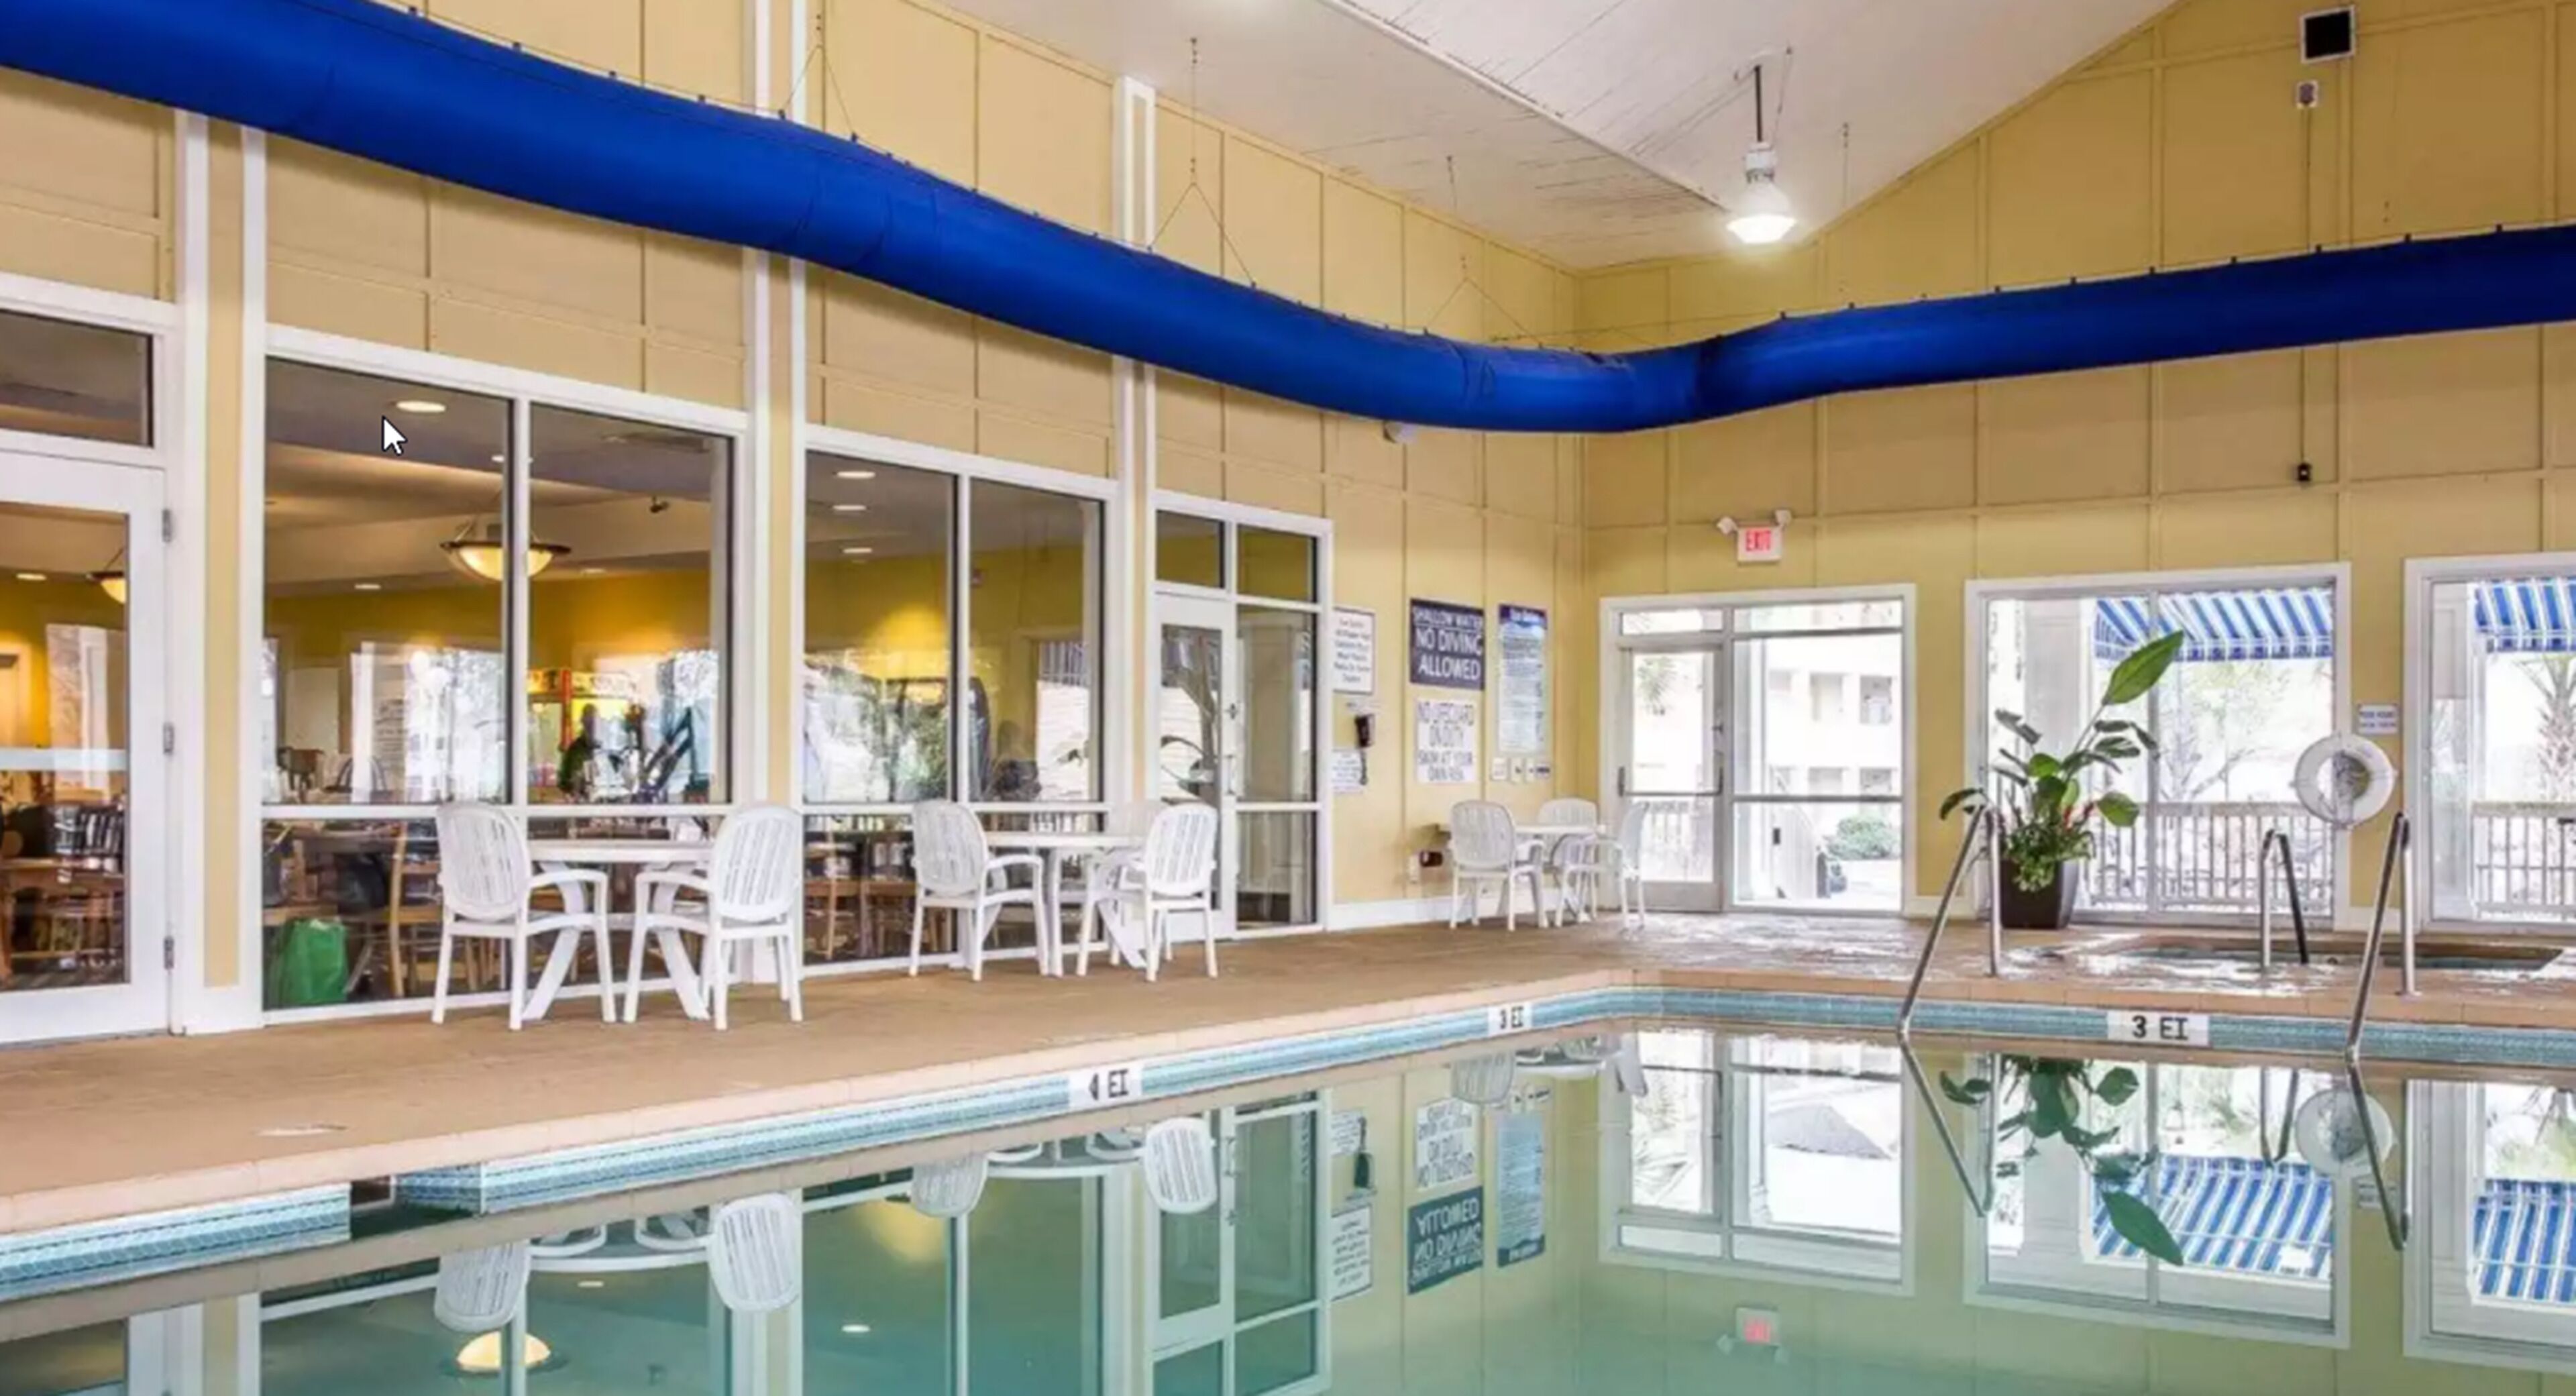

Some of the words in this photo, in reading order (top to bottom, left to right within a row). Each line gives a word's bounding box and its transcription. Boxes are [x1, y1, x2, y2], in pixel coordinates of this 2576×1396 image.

[1746, 530, 1772, 551] EXIT
[1415, 628, 1435, 650] NO
[1438, 630, 1482, 656] DIVING
[1417, 654, 1481, 680] ALLOWED
[2132, 1014, 2147, 1038] 3
